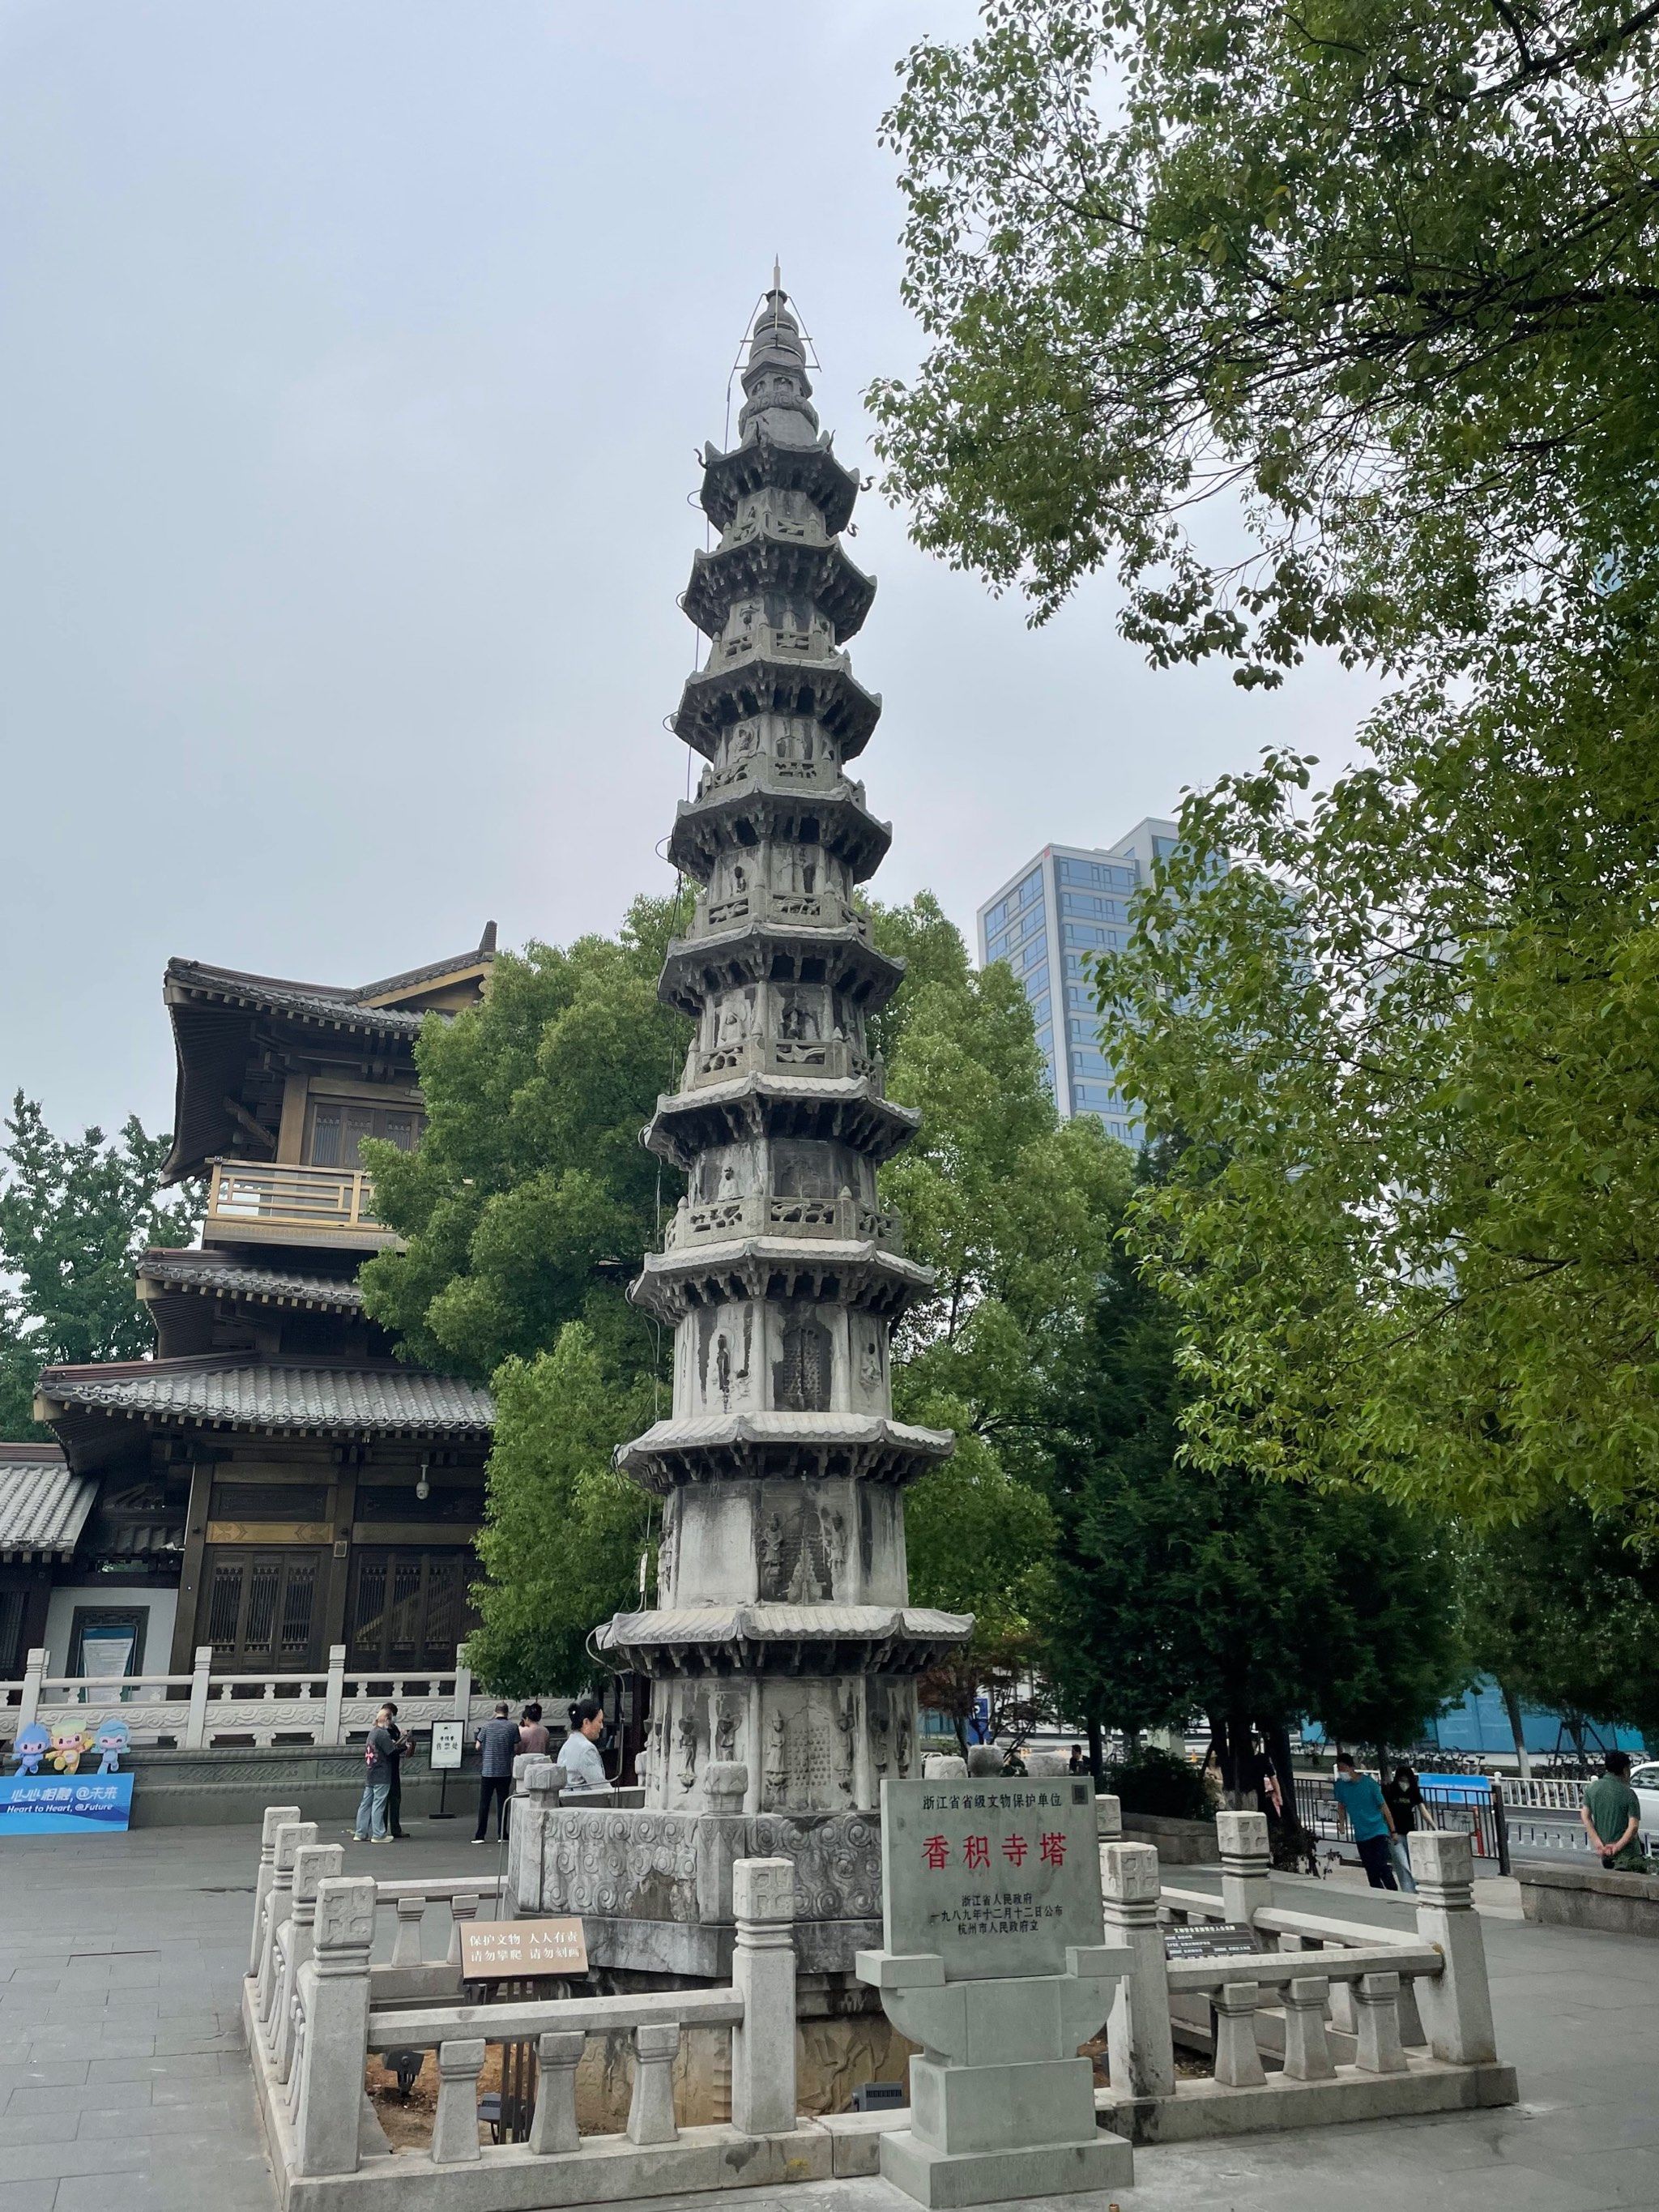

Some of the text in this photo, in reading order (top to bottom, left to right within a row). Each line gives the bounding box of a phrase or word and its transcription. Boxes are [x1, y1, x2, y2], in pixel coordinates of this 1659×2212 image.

[6, 1805, 32, 1813] Heart
[45, 1804, 73, 1813] Heart,
[75, 1803, 113, 1812] @Future
[923, 1793, 1062, 1810] 浙江省省级文物保护单位
[921, 1832, 1067, 1870] 香积寺塔
[962, 1893, 1032, 1907] 浙江省人民政府
[931, 1905, 1063, 1922] 一九八九年十二月十二日公布
[957, 1919, 1039, 1936] 杭州市人民政府立
[469, 1931, 578, 1946] 保护文物 人人有责
[471, 1946, 581, 1962] 请勿攀爬 请勿刻画
